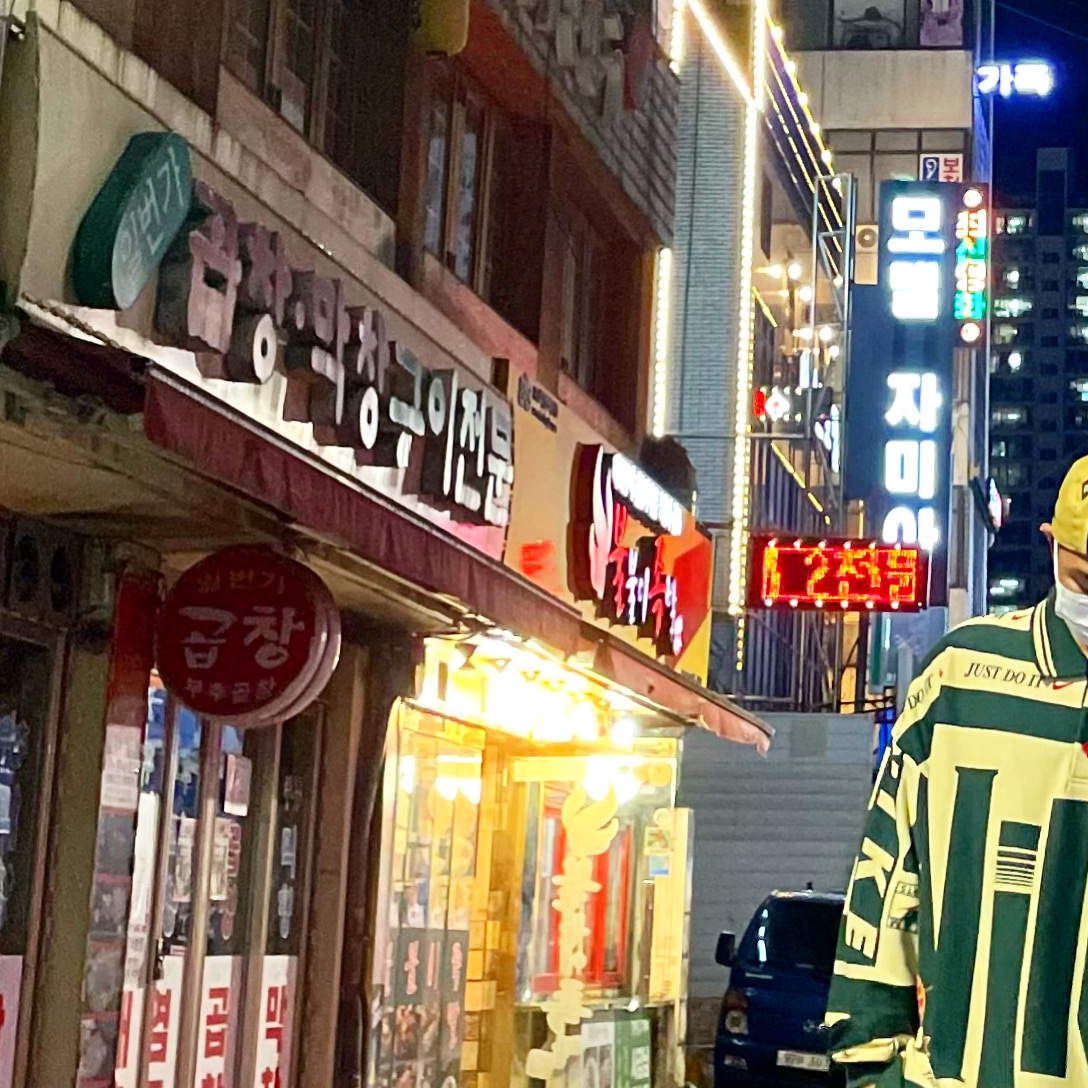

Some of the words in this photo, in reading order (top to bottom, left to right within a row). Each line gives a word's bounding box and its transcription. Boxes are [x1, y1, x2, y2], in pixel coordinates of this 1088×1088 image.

[178, 605, 306, 670] 곱창
[963, 661, 1003, 680] JUST
[1003, 669, 1027, 684] DO
